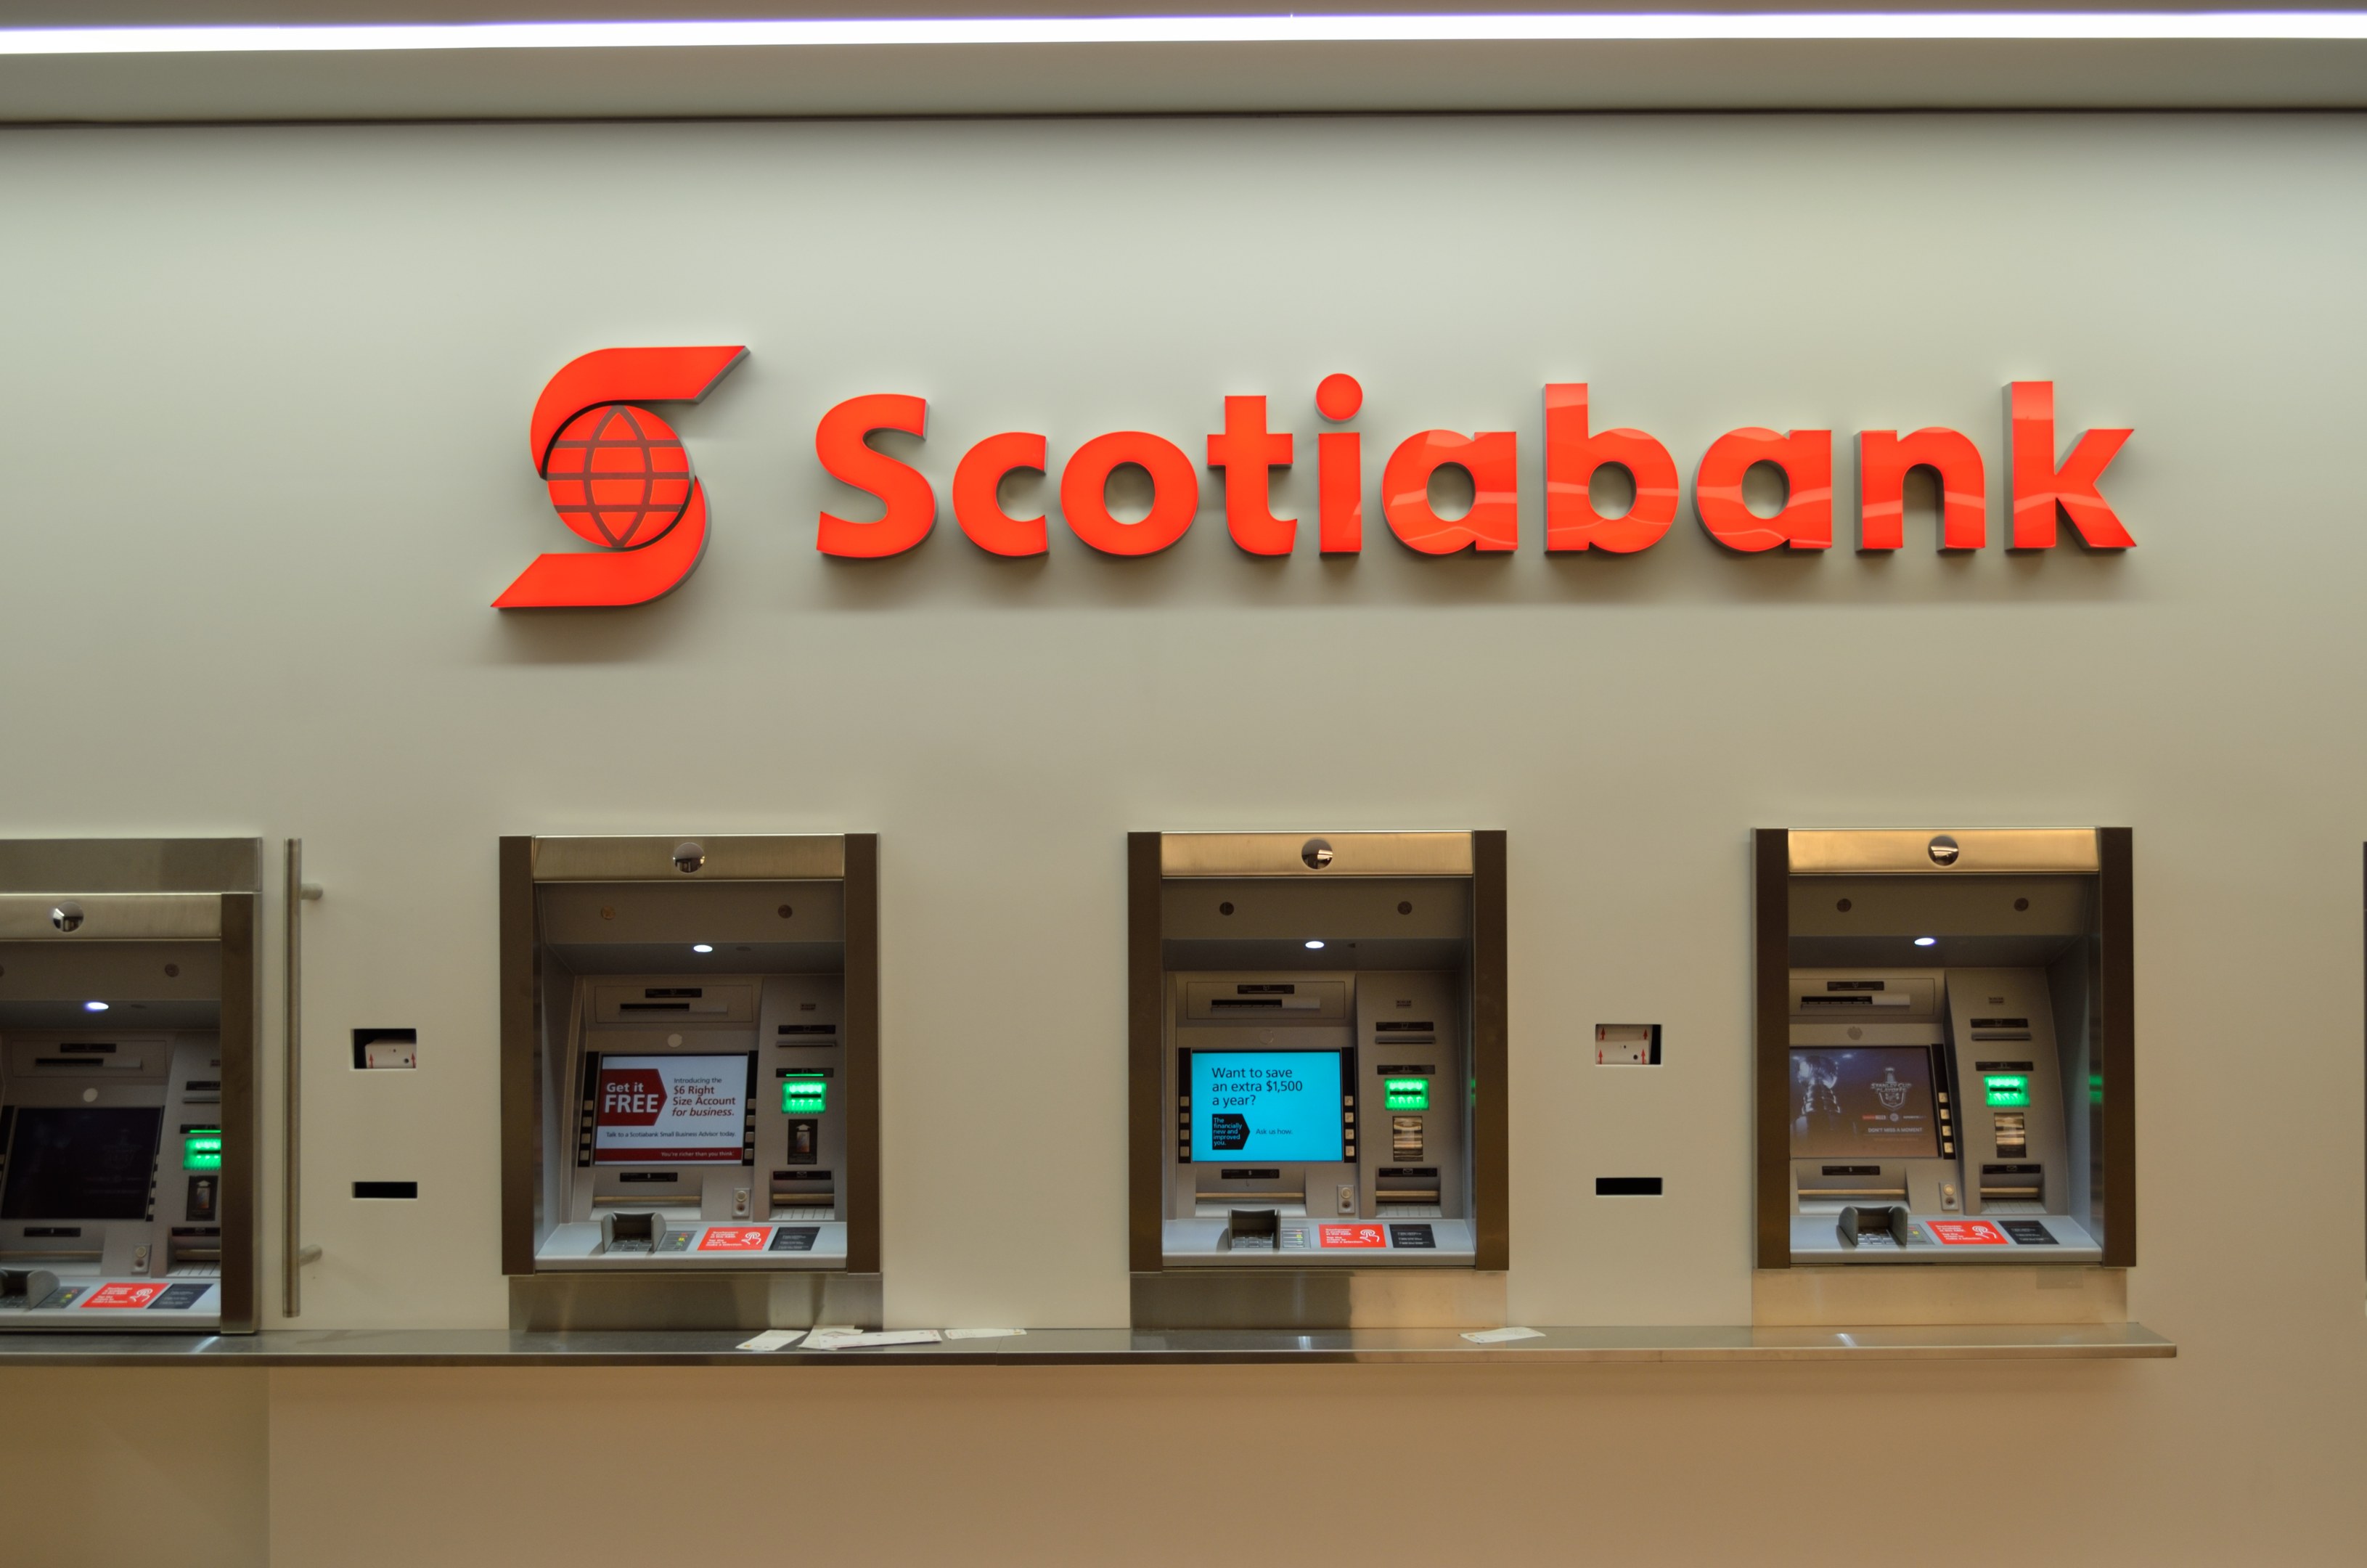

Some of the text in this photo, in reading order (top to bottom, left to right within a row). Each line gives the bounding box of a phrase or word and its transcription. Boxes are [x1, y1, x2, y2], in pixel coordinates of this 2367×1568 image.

[815, 373, 2137, 558] Scotiabank
[1211, 1068, 1293, 1078] Want to save
[607, 1082, 644, 1093] Get it
[674, 1085, 715, 1097] $6 Right
[1212, 1080, 1303, 1092] an extra $1,500
[604, 1094, 659, 1114] FREE
[673, 1095, 736, 1106] Size Account
[1223, 1095, 1256, 1108] year?
[672, 1107, 734, 1116] for business.
